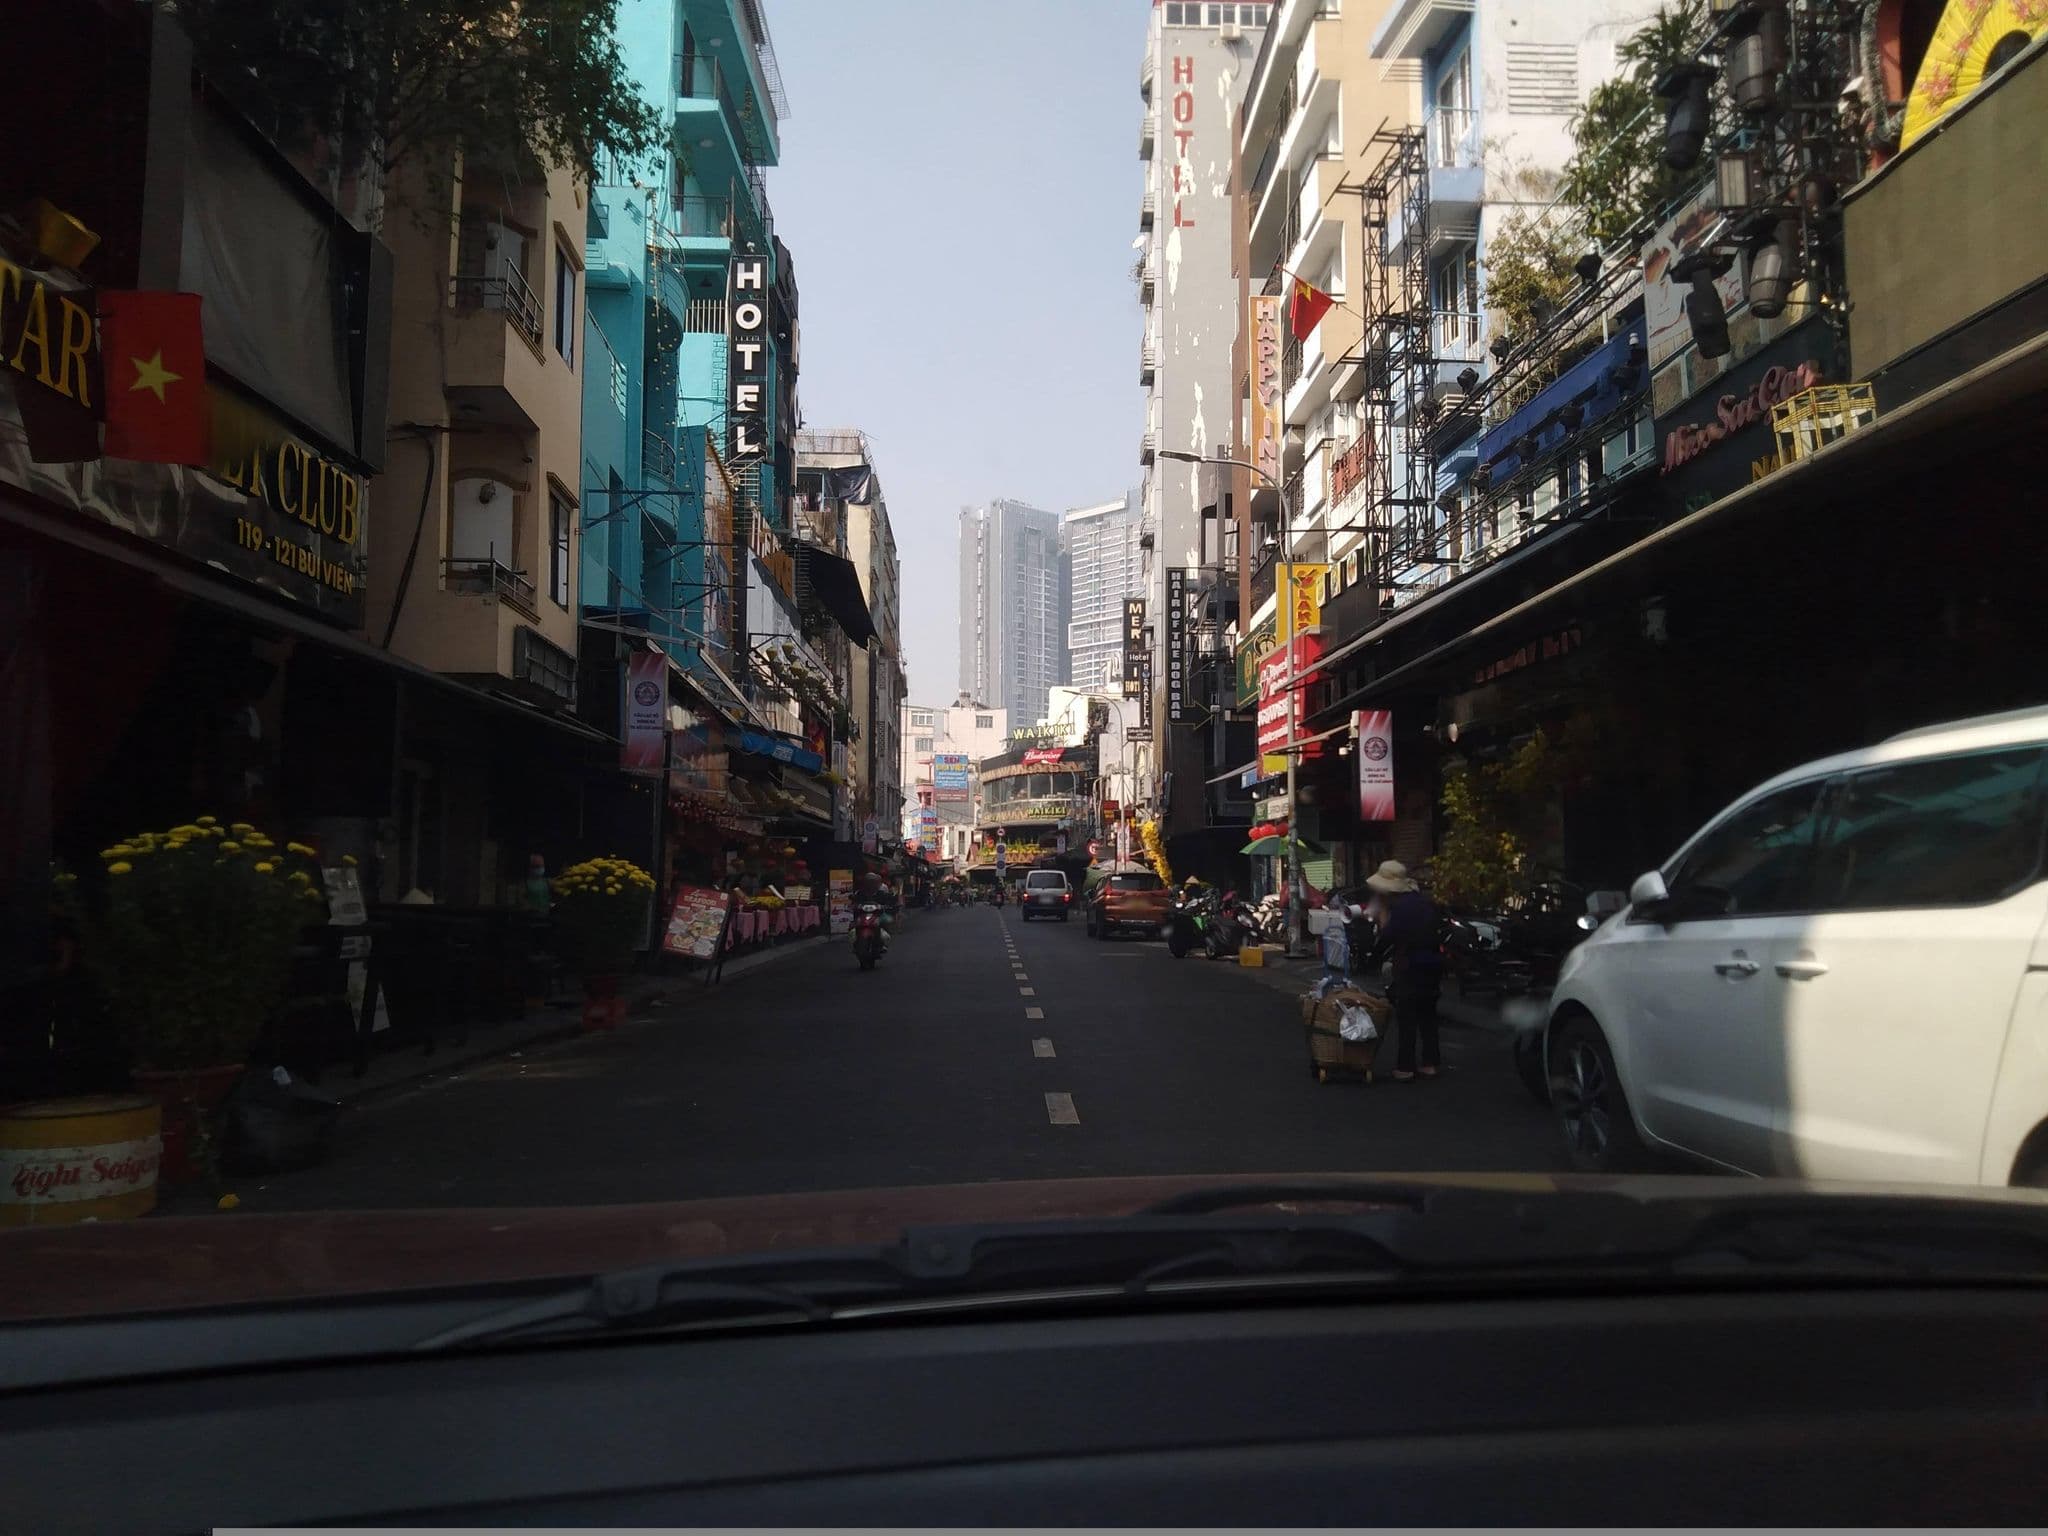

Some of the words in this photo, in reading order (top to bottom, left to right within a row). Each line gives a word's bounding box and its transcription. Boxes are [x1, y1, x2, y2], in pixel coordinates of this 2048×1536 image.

[736, 262, 762, 453] HOTEL
[1256, 301, 1276, 406] HAPPY
[1258, 417, 1276, 480] INN
[278, 439, 359, 545] CLUB
[236, 516, 263, 551] 119
[273, 535, 297, 569] 121
[1171, 572, 1181, 608] HAIR
[1171, 611, 1181, 628] OF
[1129, 652, 1150, 661] Hotel
[1171, 632, 1181, 658] THE
[1171, 662, 1181, 689] DOG
[1171, 693, 1181, 719] BAR
[1013, 723, 1076, 740] WAIKIKI
[1028, 806, 1066, 816] WAIKIKI
